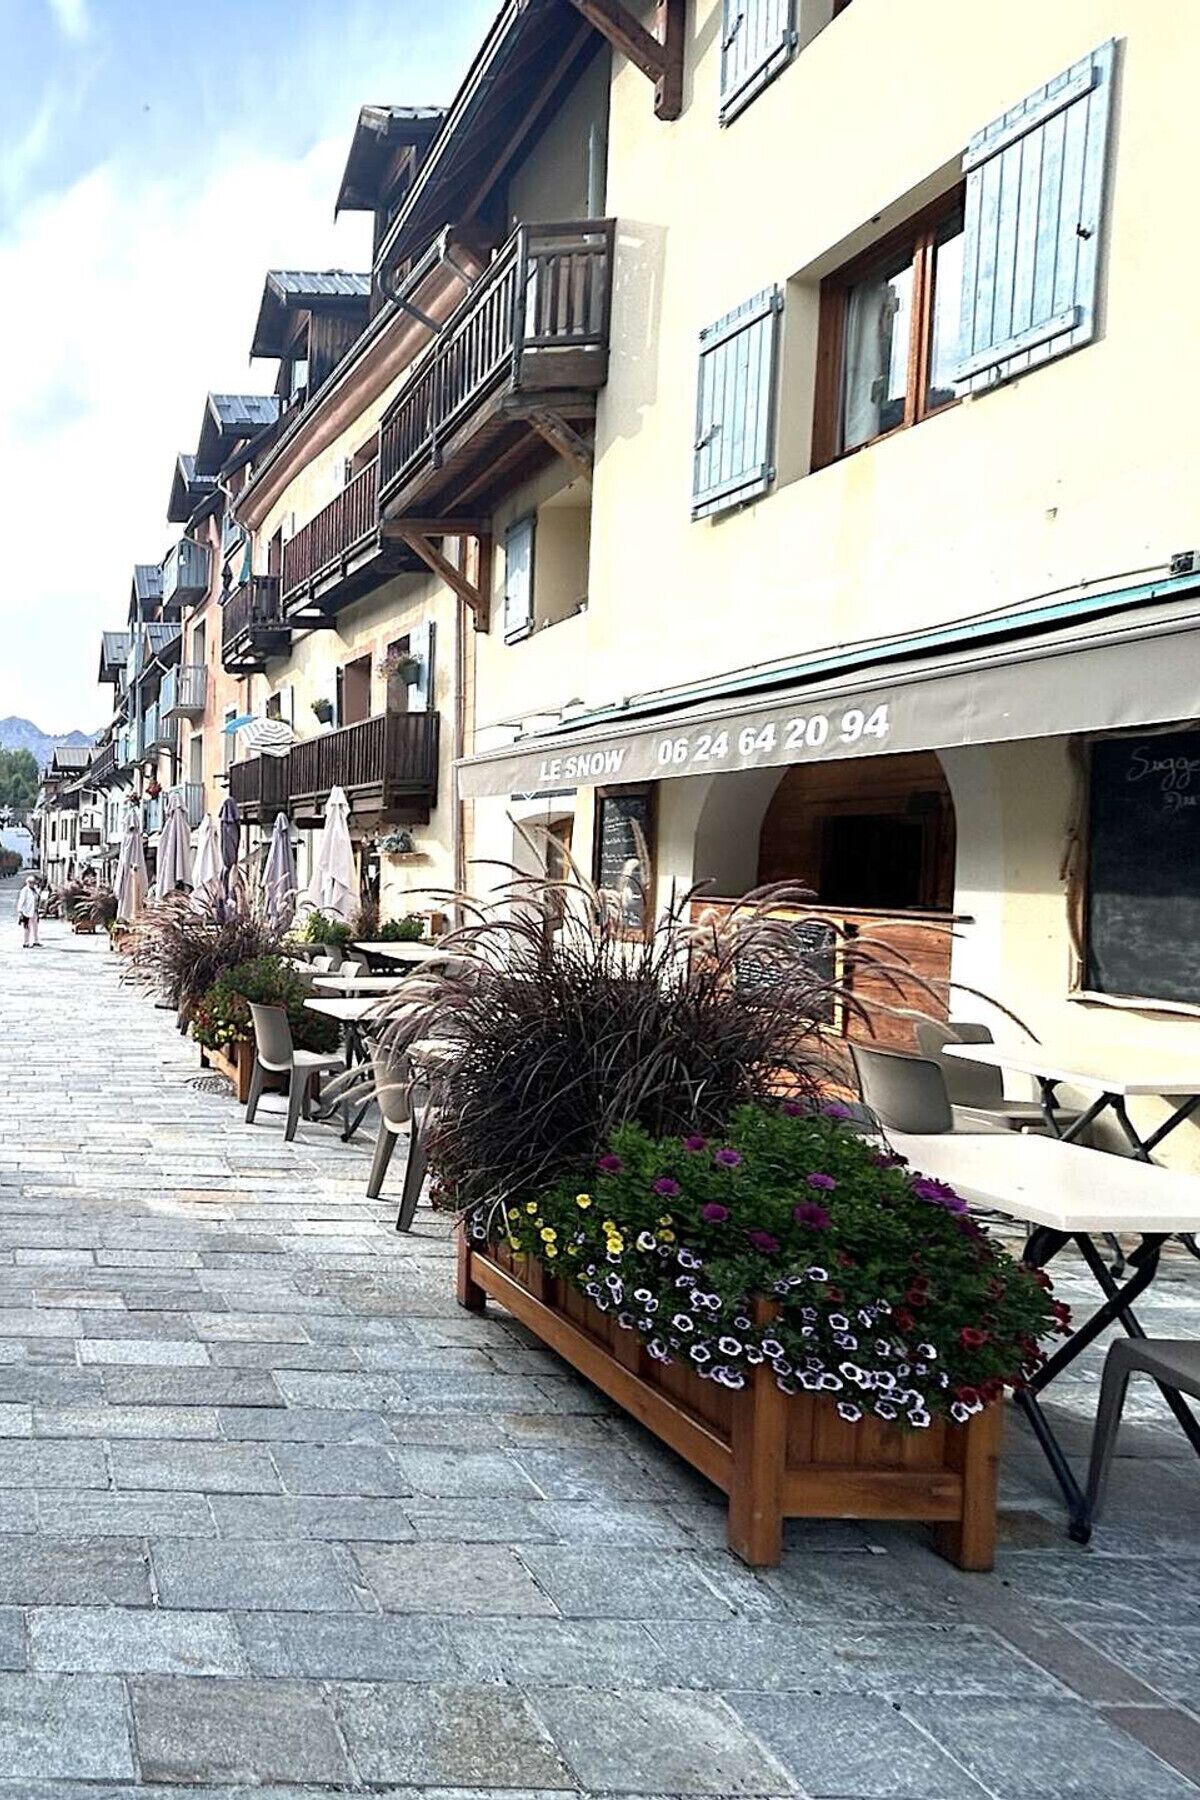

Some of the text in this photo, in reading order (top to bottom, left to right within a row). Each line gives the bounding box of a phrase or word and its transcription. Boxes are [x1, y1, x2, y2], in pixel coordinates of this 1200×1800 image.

[658, 703, 890, 765] 06 24 64 20 94
[539, 748, 626, 781] LE SNOW
